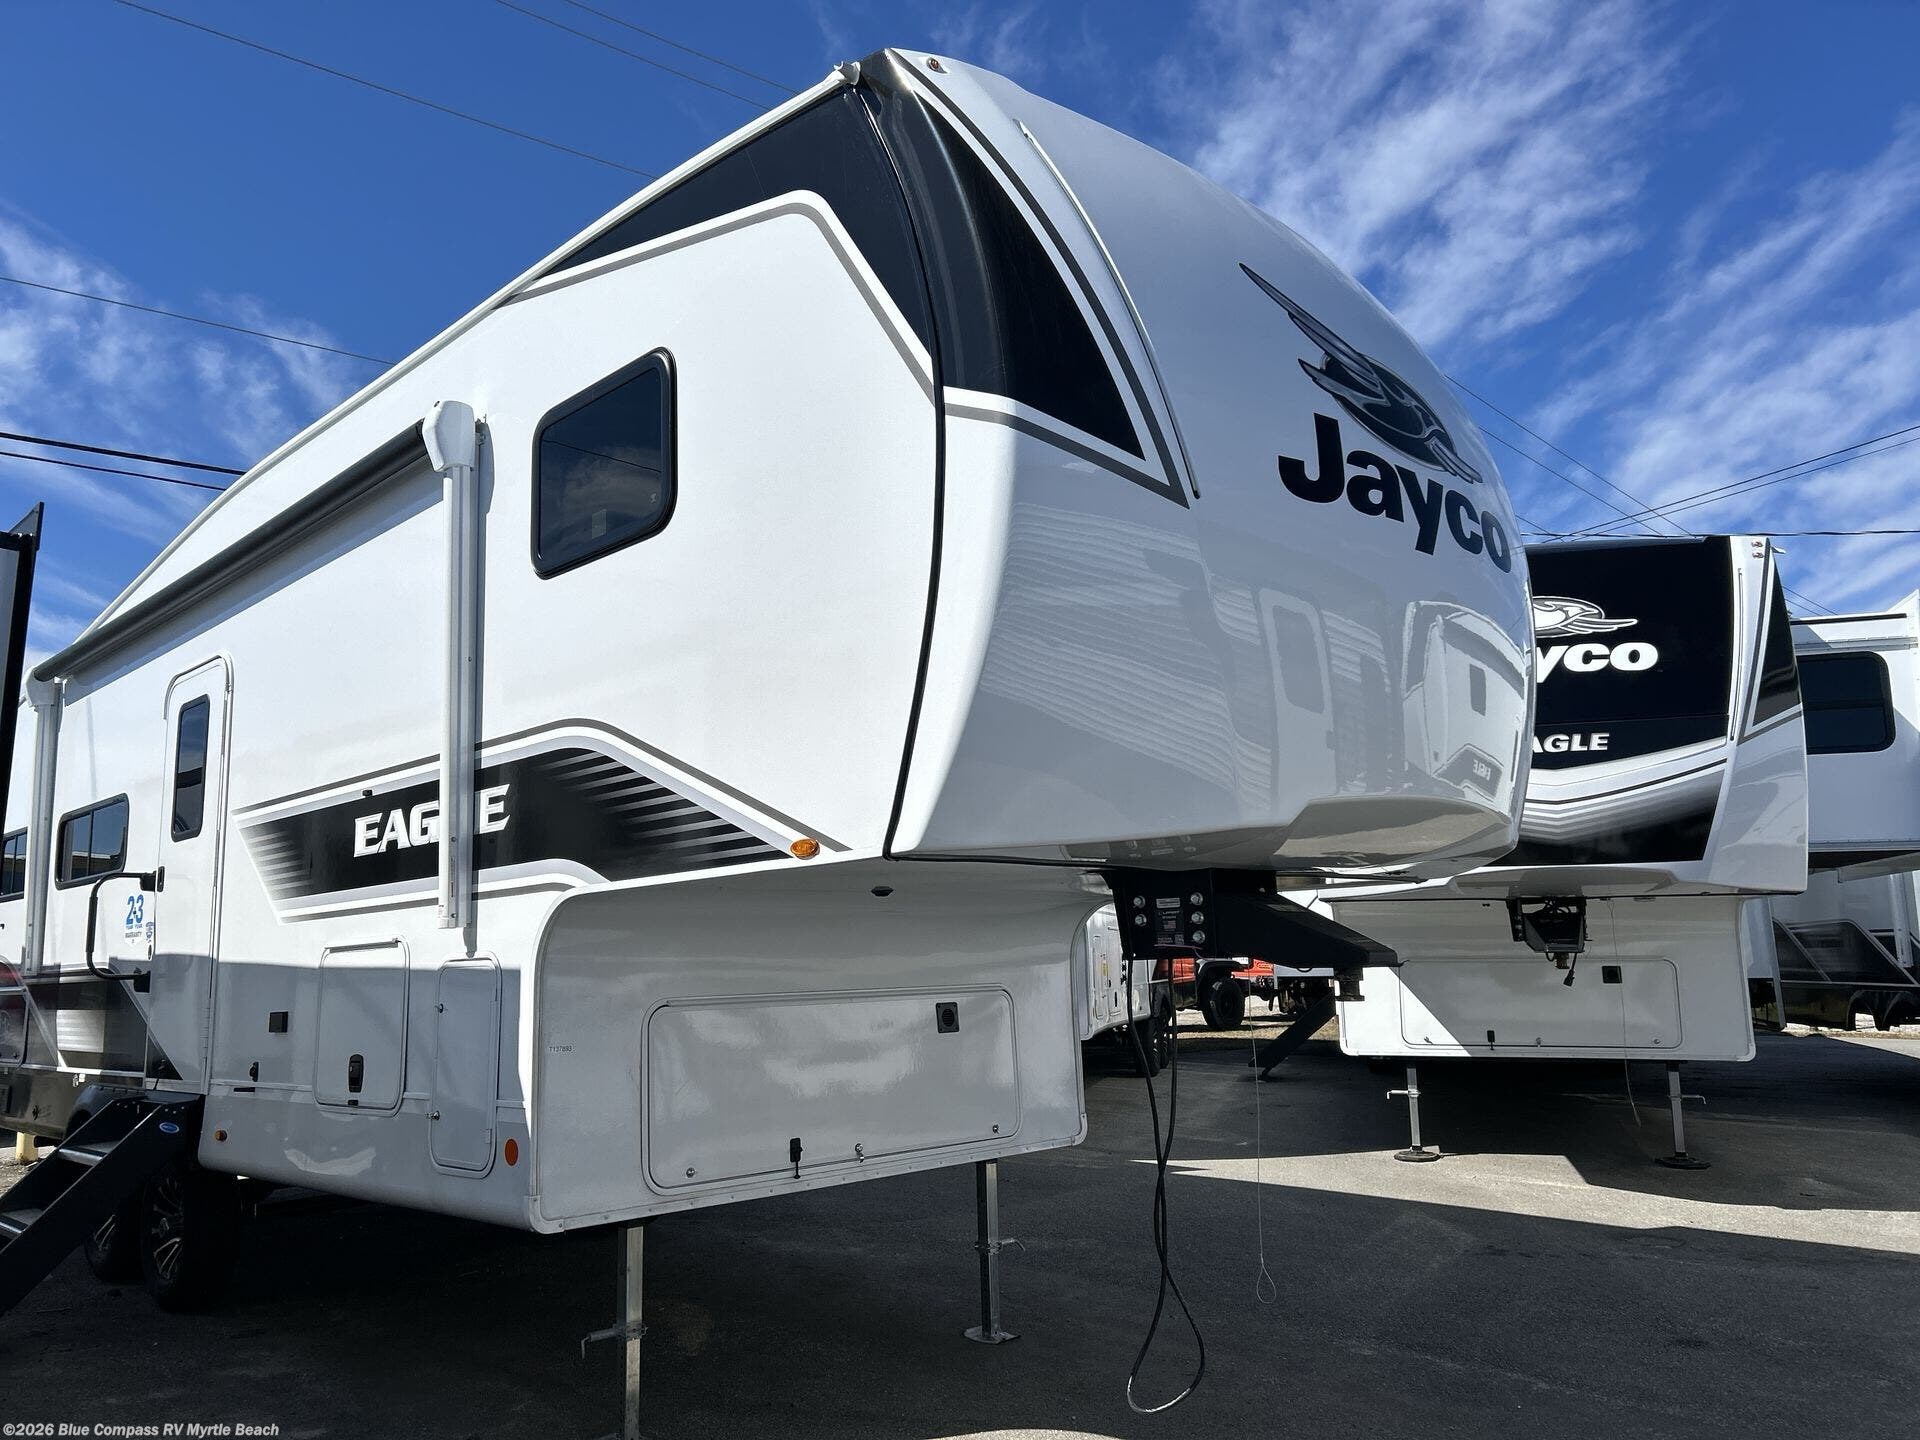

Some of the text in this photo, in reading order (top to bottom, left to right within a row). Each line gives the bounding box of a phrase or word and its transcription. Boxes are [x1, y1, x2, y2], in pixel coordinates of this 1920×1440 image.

[1278, 412, 1512, 573] Jayco
[1536, 642, 1658, 683] yco
[1533, 733, 1610, 753] AGLE
[353, 783, 511, 858] EAGE
